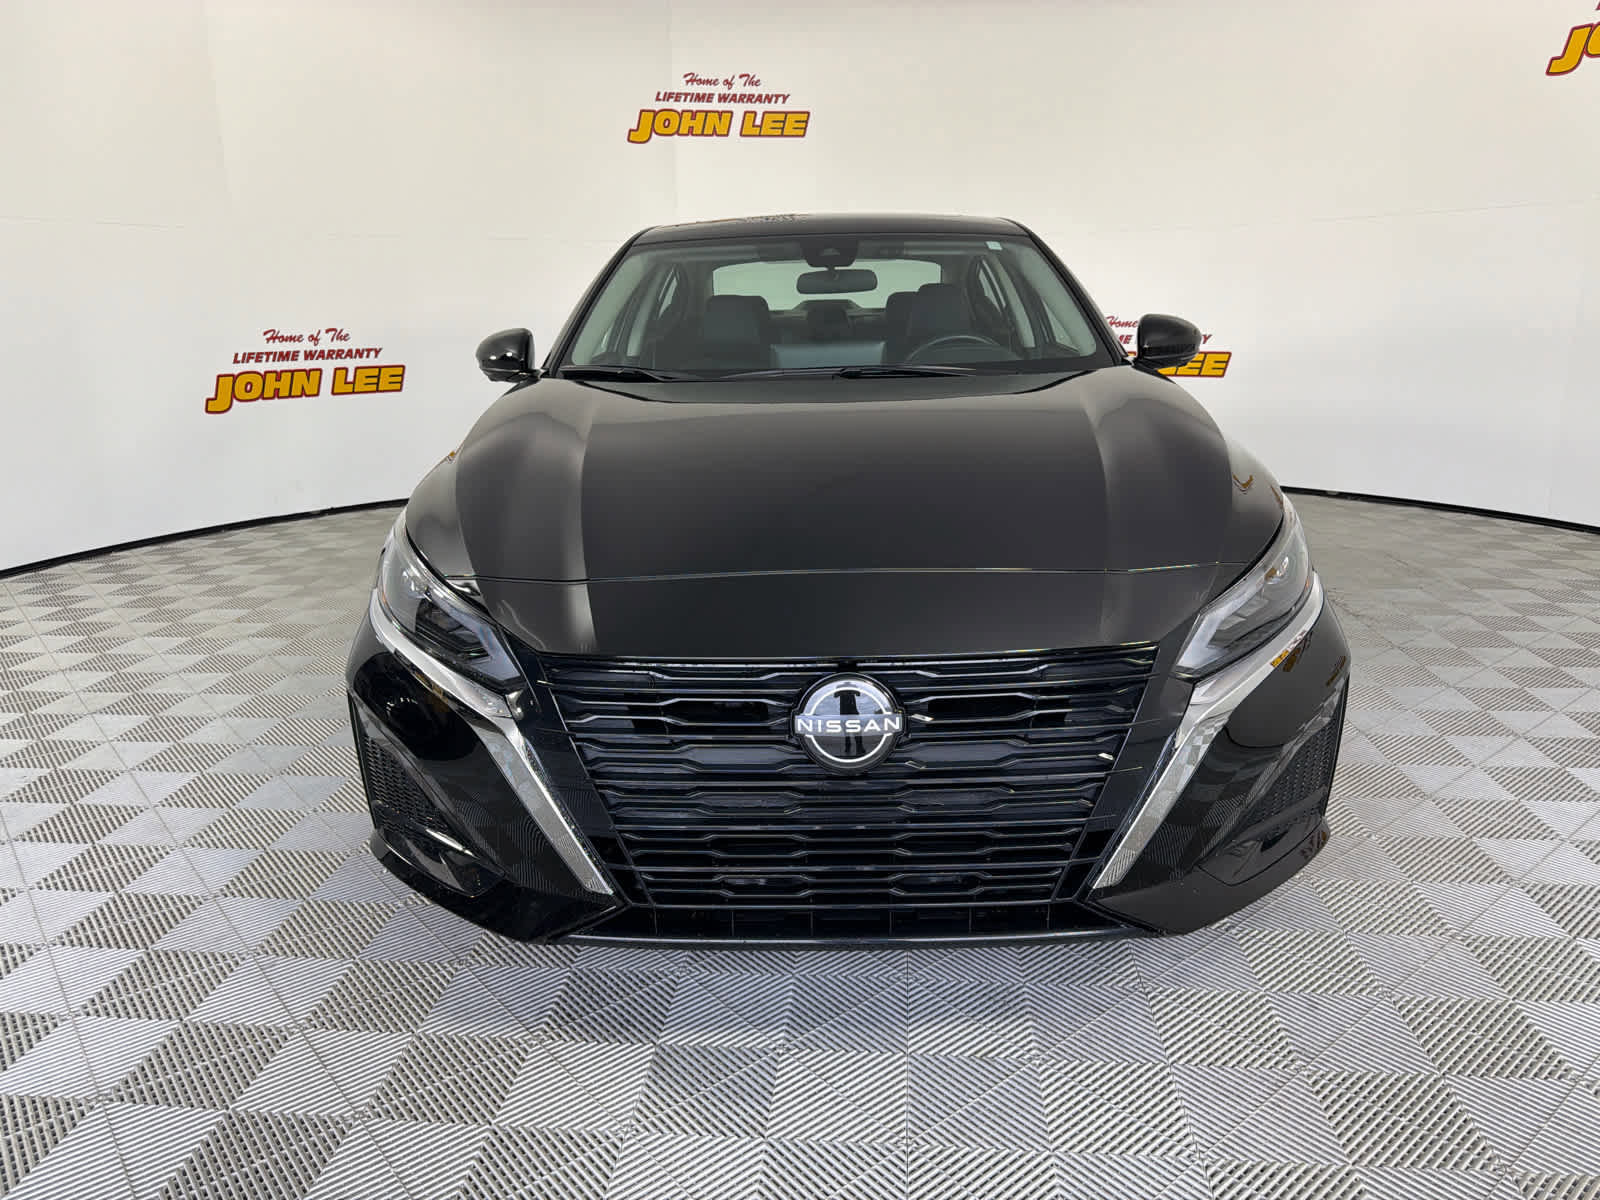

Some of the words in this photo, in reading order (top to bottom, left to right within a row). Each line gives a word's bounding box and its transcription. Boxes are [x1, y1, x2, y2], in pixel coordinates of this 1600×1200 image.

[683, 72, 719, 87] Home
[723, 75, 735, 90] of
[739, 73, 761, 87] The
[655, 91, 714, 103] LIFETIME
[717, 93, 790, 104] WARRANTY
[627, 109, 733, 144] JOHN
[740, 111, 810, 137] LEE
[263, 329, 304, 344] Home
[308, 330, 320, 346] of
[325, 328, 350, 342] The
[233, 350, 300, 364] LIFETIME
[303, 347, 382, 361] WARRANTY
[205, 368, 322, 414] JOHN
[331, 365, 405, 395] LEE
[797, 717, 900, 733] NISSAN
